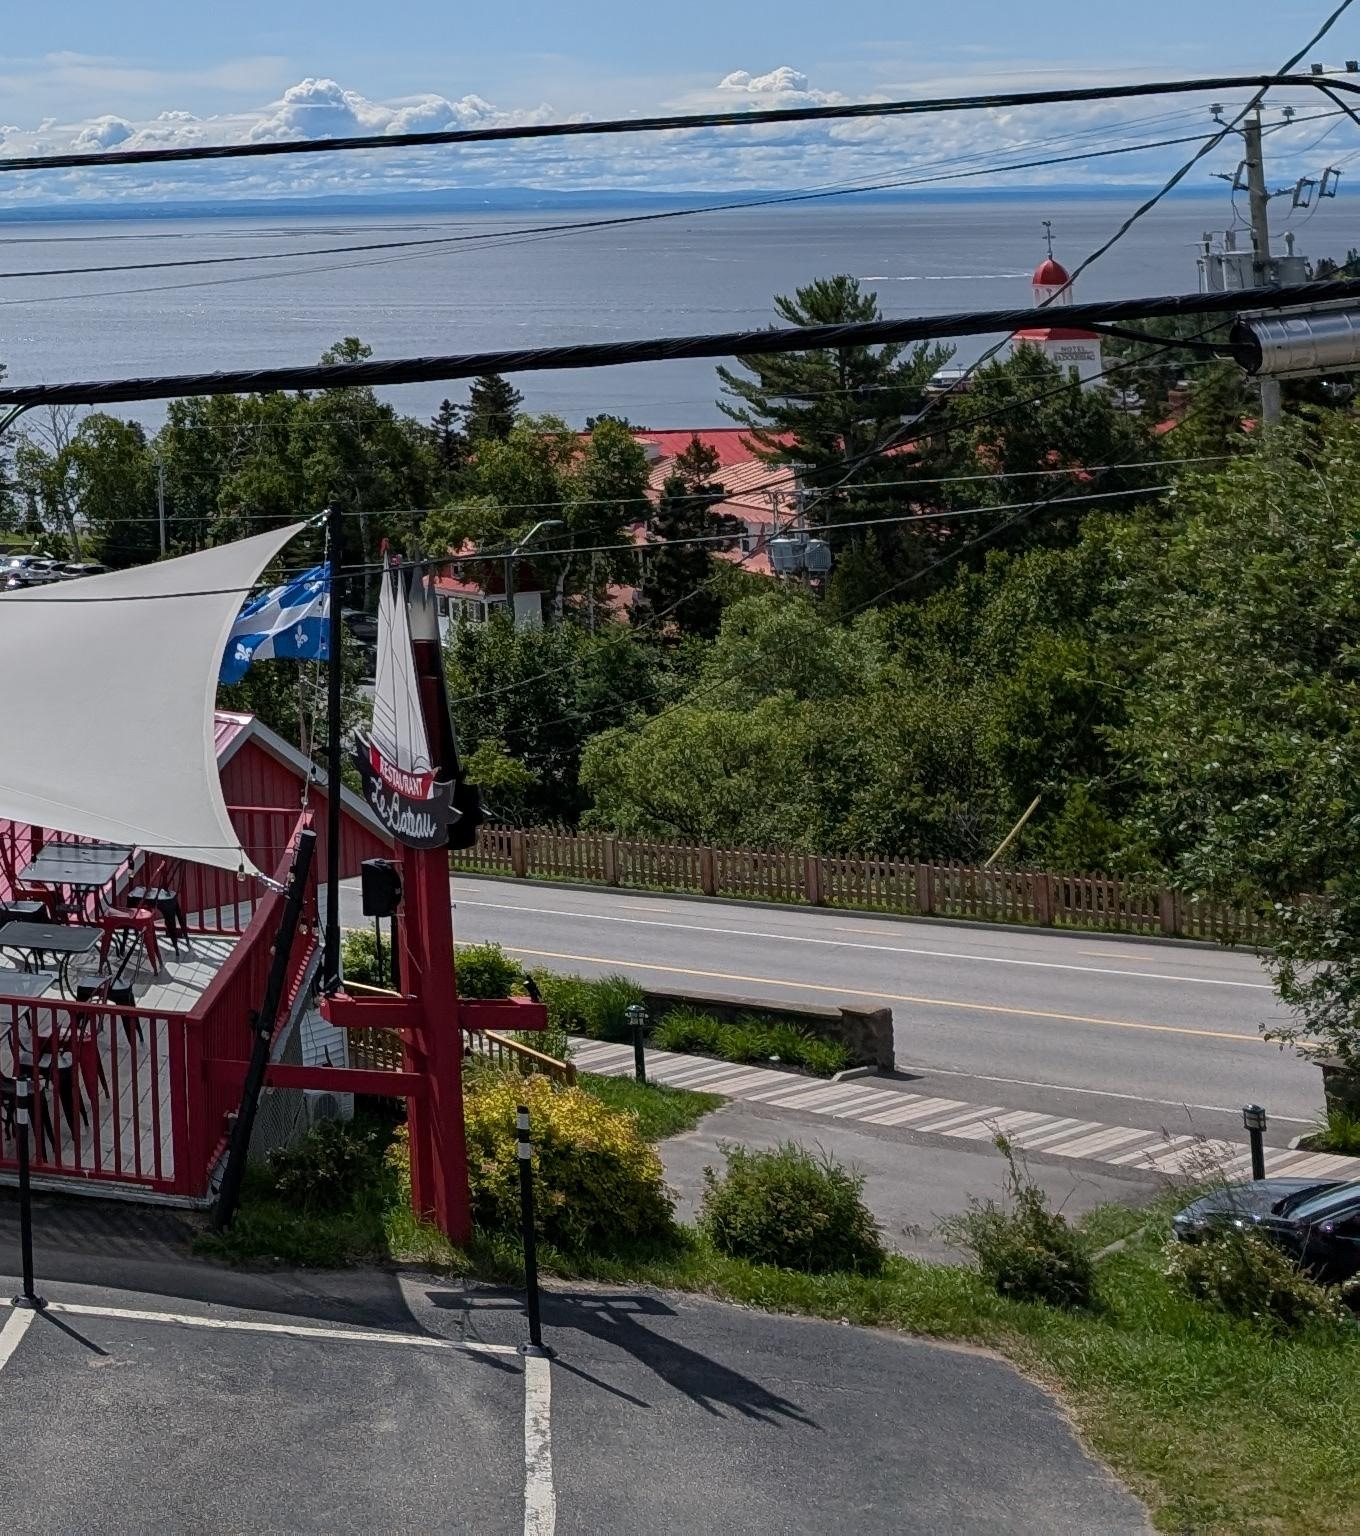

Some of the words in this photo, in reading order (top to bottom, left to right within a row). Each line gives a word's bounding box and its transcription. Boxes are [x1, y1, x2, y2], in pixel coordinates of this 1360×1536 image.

[379, 755, 424, 797] RESTAURANT
[370, 776, 389, 819] Le
[386, 791, 438, 839] Bateau
